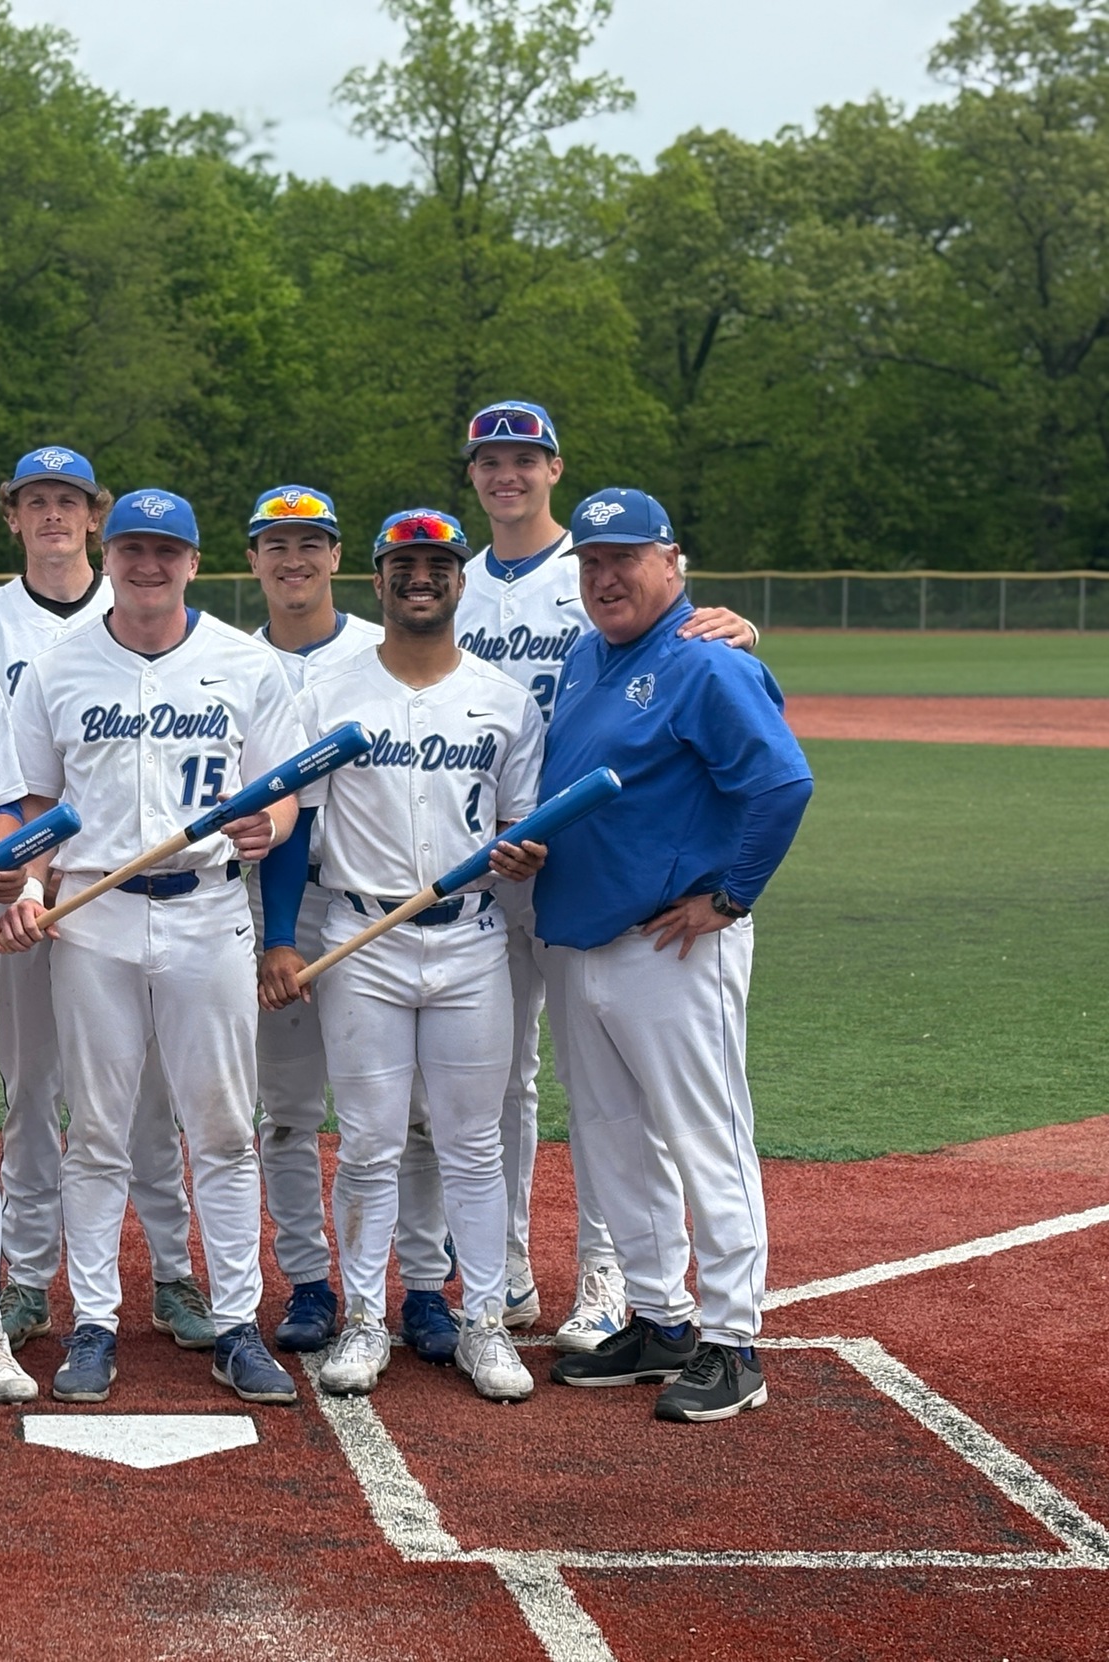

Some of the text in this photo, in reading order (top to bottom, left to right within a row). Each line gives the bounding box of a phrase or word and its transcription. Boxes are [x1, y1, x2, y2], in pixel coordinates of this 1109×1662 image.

[509, 624, 581, 661] Devil
[81, 703, 228, 743] Blue Devils
[420, 733, 497, 772] Devils
[179, 755, 227, 808] 15
